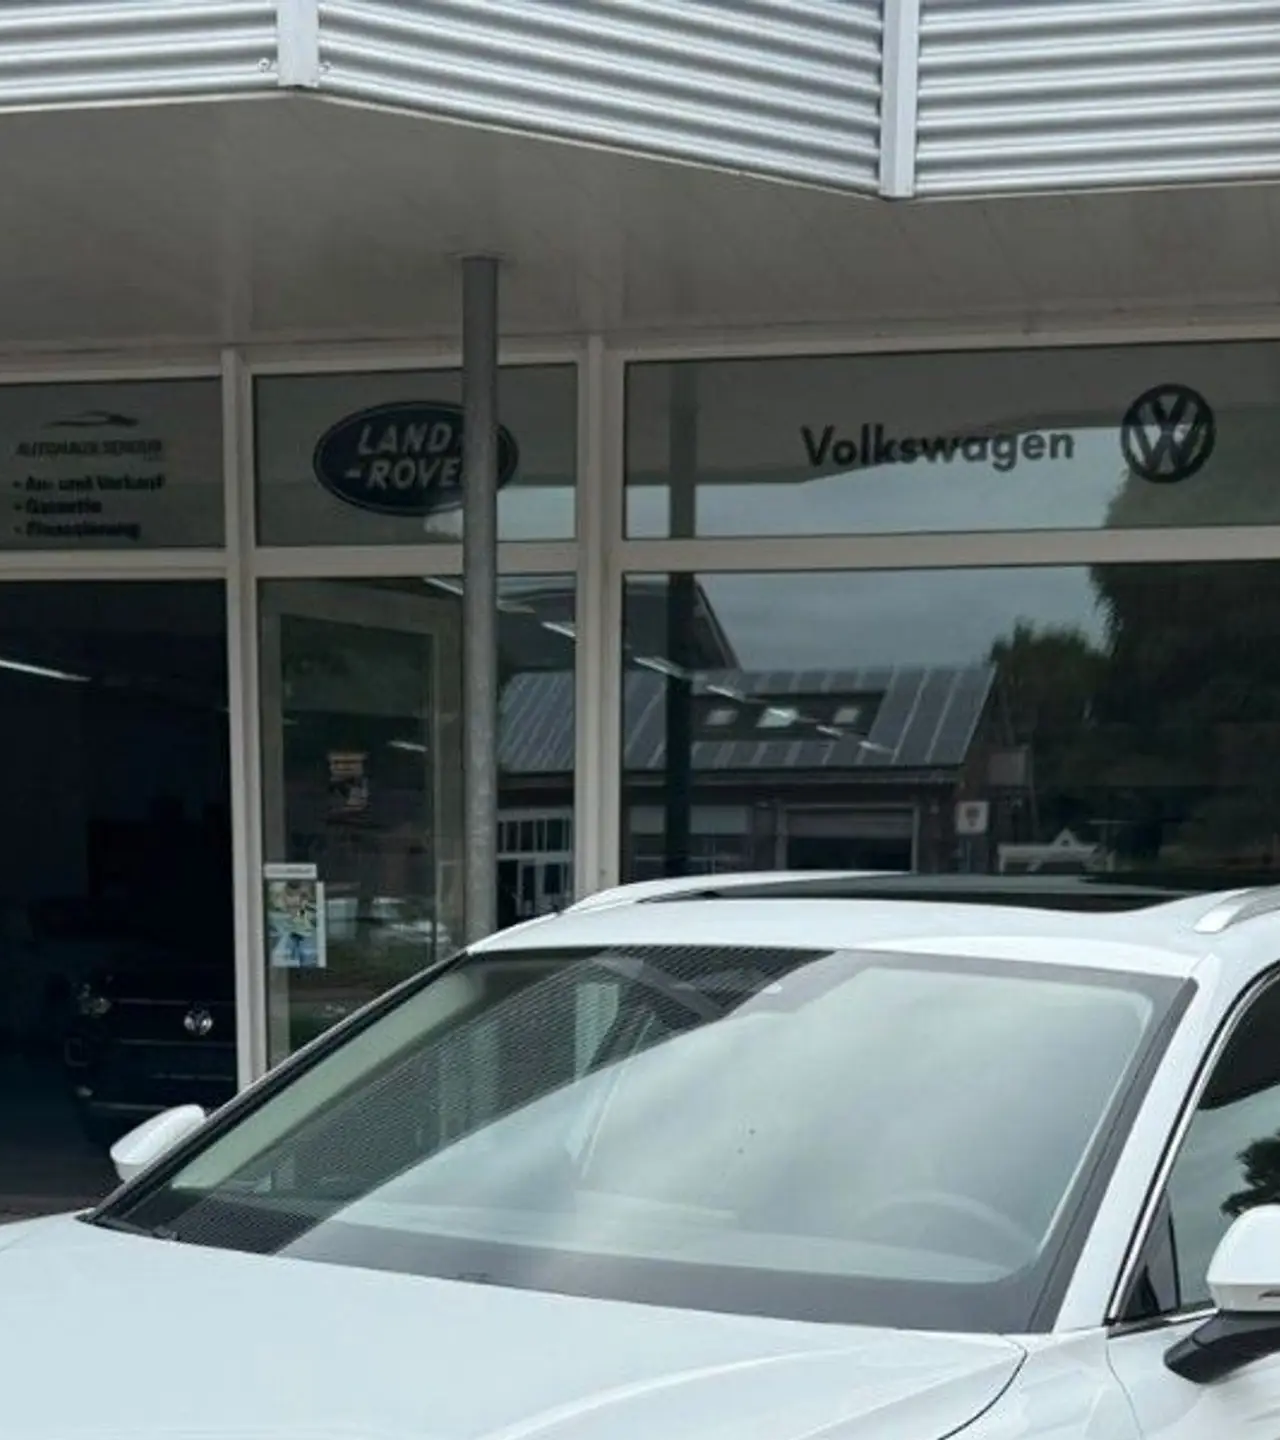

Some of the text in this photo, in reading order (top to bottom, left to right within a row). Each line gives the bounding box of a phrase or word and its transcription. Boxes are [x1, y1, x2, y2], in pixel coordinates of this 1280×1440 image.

[357, 421, 454, 455] LAND
[800, 422, 1075, 473] Volkswagen
[367, 455, 465, 490] ROVE
